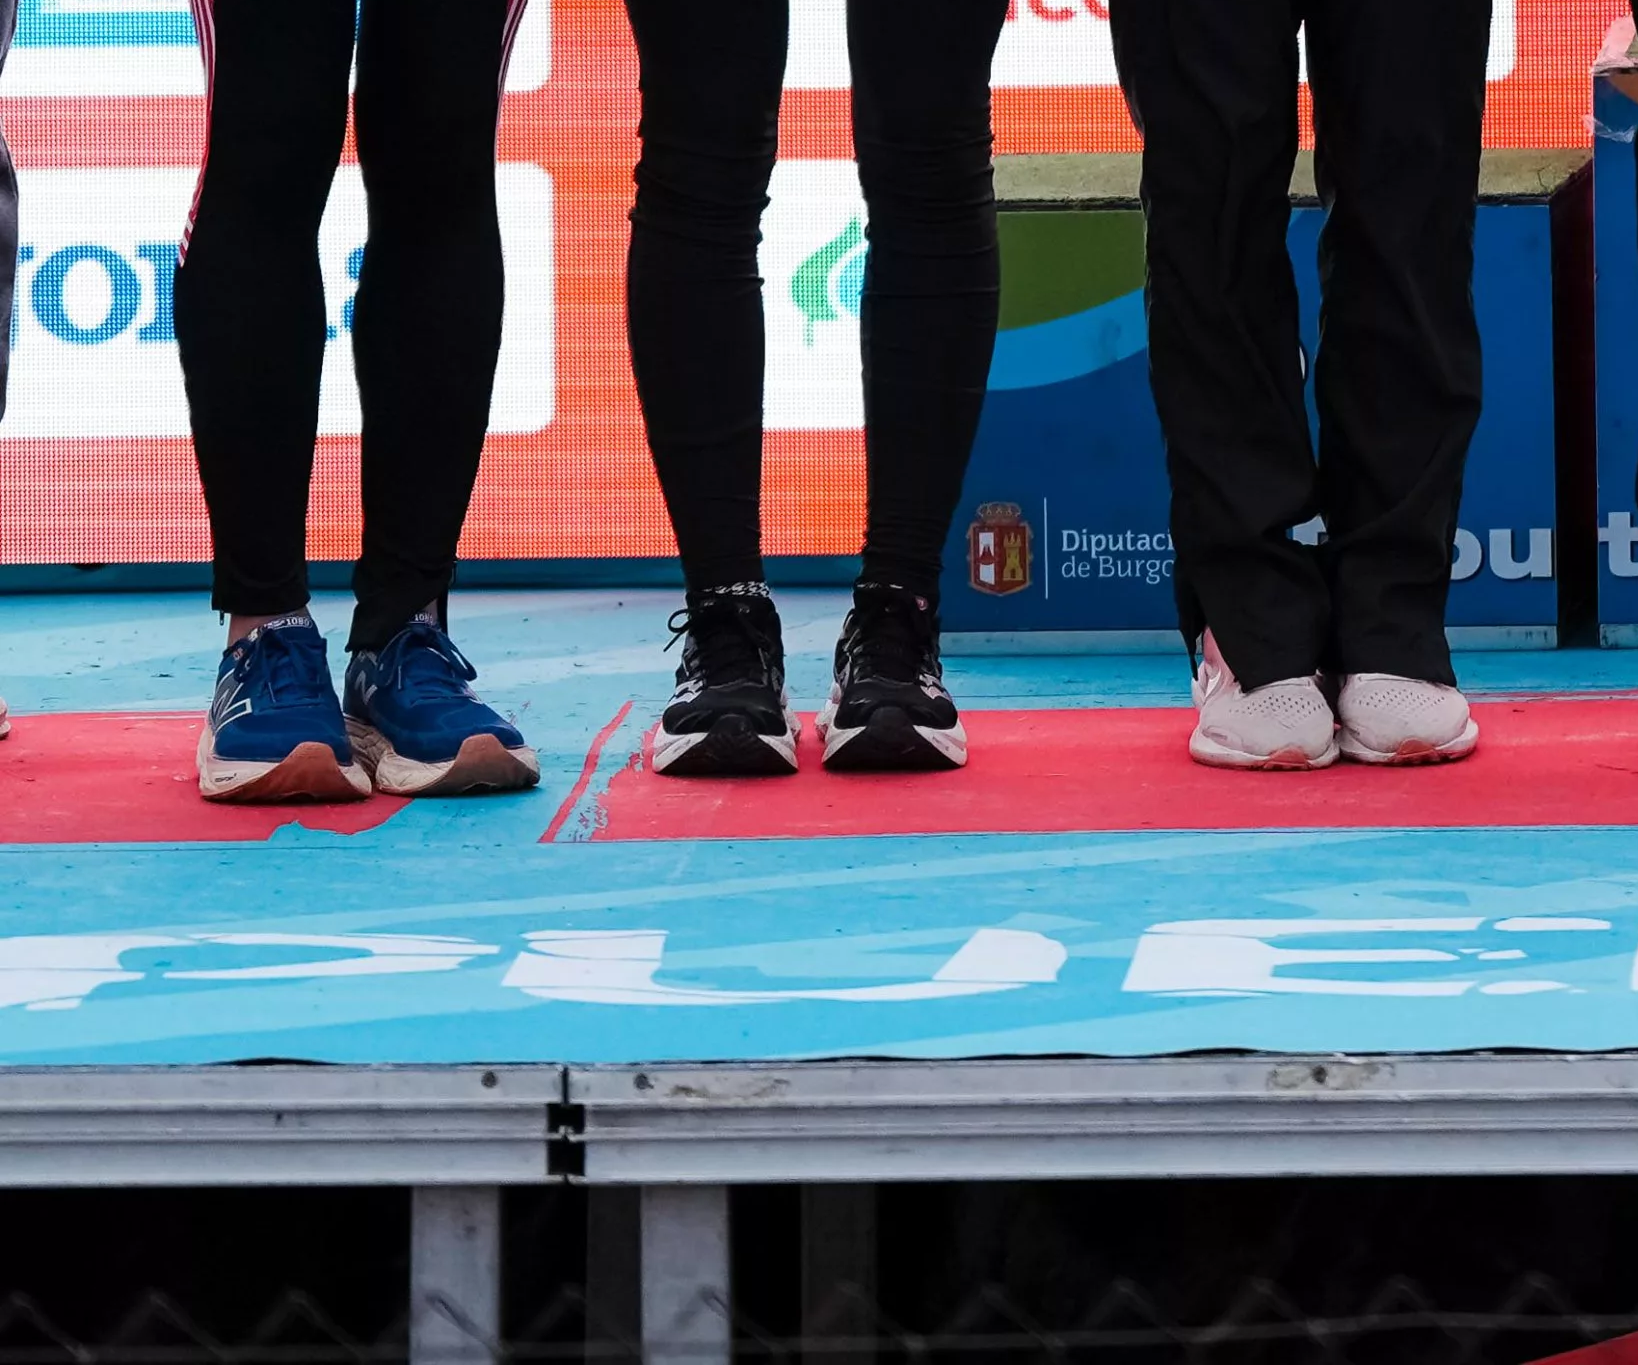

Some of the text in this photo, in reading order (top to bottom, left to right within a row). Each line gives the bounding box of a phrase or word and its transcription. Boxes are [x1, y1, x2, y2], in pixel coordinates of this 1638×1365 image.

[1061, 528, 1176, 559] Diputaci
[1061, 555, 1175, 585] de Burgo
